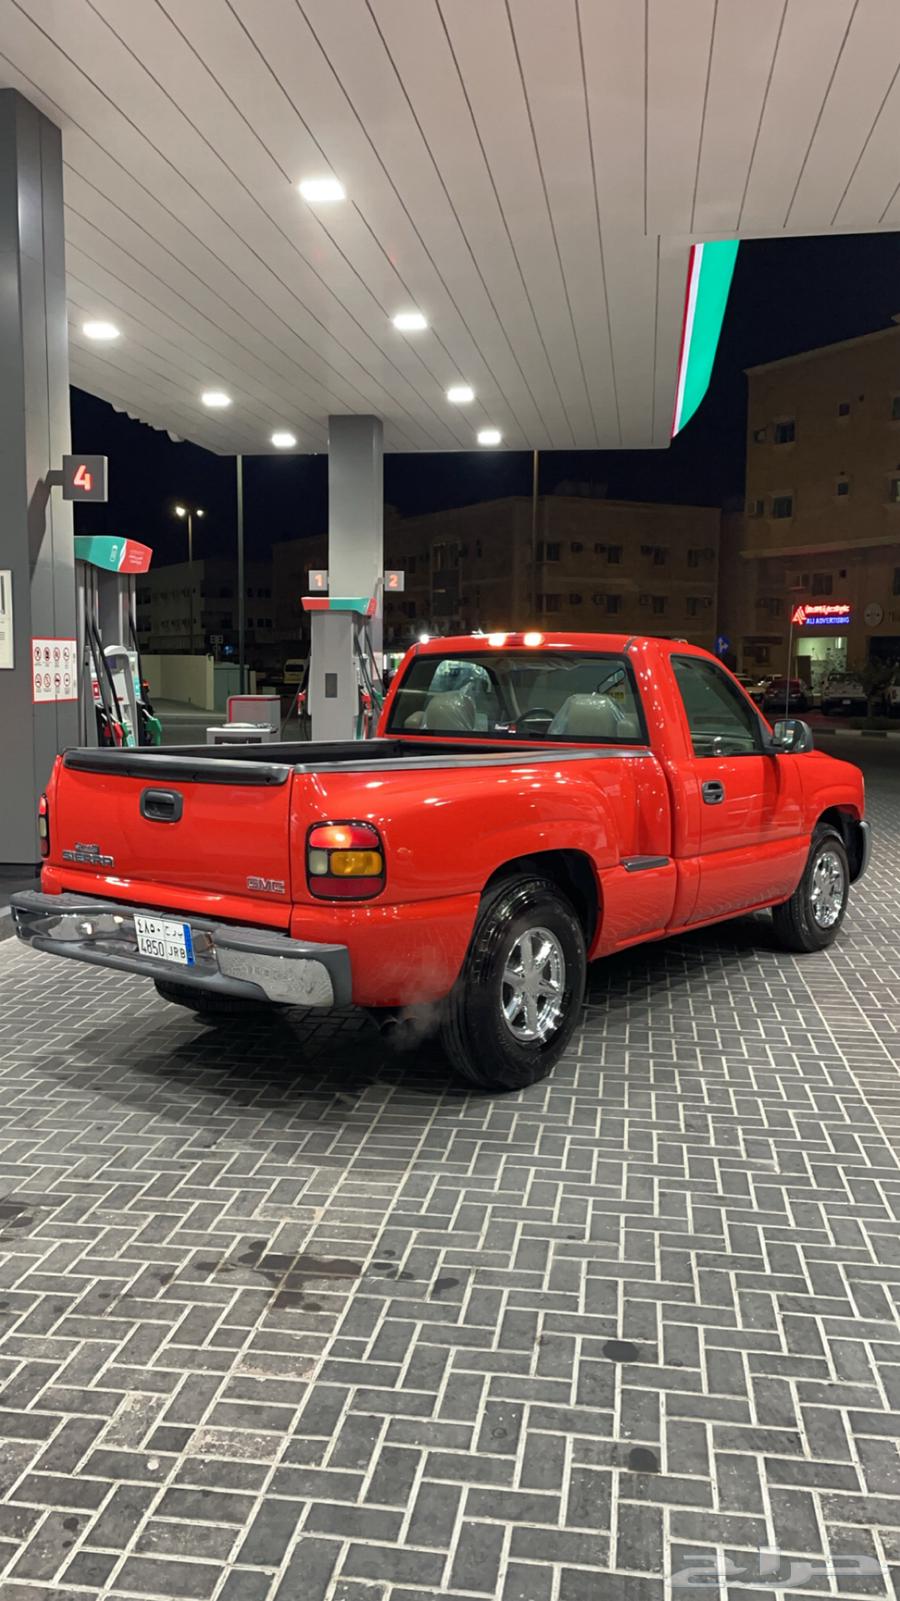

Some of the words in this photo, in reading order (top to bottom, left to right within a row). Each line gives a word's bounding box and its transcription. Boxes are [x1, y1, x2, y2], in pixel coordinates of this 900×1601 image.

[73, 464, 92, 491] 4
[315, 574, 323, 587] 1
[389, 574, 398, 587] 2
[62, 850, 114, 867] SIERRA
[246, 876, 285, 894] GMC
[140, 938, 165, 957] 4850
[168, 945, 186, 959] JRB
